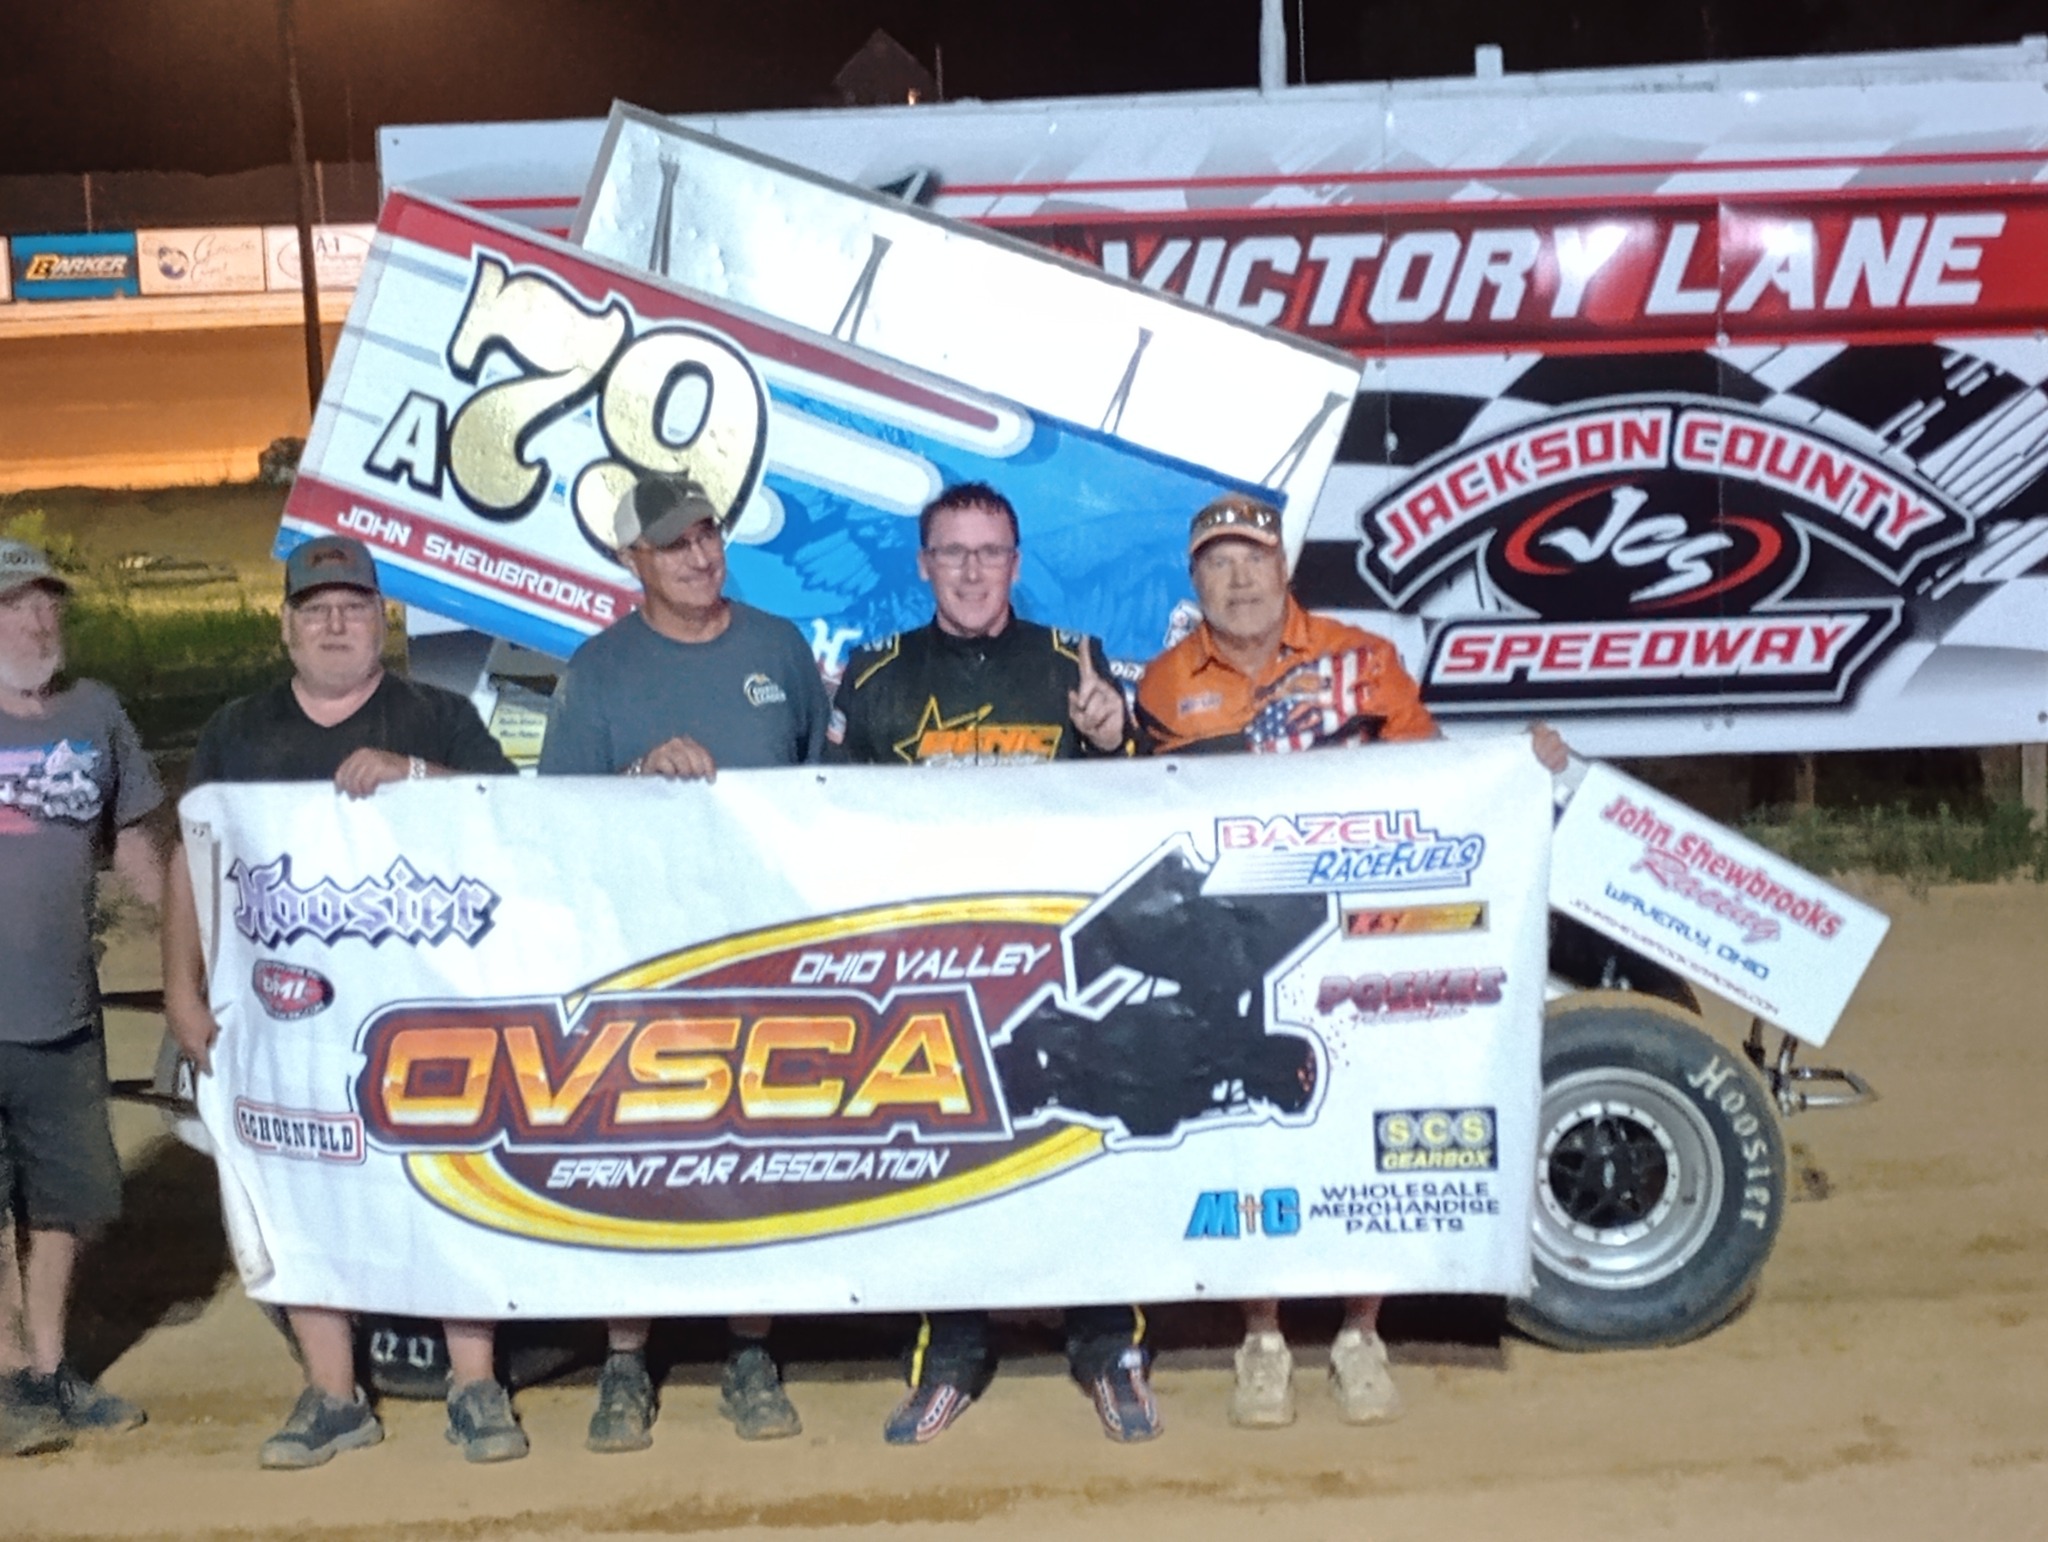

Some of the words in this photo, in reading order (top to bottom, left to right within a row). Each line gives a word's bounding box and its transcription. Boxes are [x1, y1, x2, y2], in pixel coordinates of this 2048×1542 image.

[26, 253, 128, 279] BARKER
[1102, 225, 1628, 327] VICTORY
[1645, 213, 2007, 316] LANE
[1378, 414, 1667, 562] JACKSON
[1680, 416, 1930, 546] COUNTY
[337, 505, 413, 547] JOHN
[422, 532, 616, 611] SHEWBROOKS
[1441, 624, 1850, 676] SPEEDWAY
[1219, 814, 1434, 850] BAZELL
[1603, 795, 1676, 851] John
[1674, 830, 1846, 940] Shewbrooks
[226, 852, 502, 950] Hoosier
[1630, 846, 1783, 944] Racing
[791, 949, 887, 984] OHIO
[896, 942, 1052, 982] VALLEY
[1716, 943, 1771, 981] OHIO
[382, 1012, 973, 1127] OVSCA
[238, 1109, 354, 1152] SCHOENFELD
[1381, 1112, 1493, 1149] SCS
[546, 1155, 668, 1189] SPRINT
[664, 1153, 741, 1187] CAR
[740, 1149, 951, 1185] ASSOCIATION
[1381, 1149, 1493, 1171] GEARBOX
[1308, 1199, 1501, 1218] MERCHANDISE
[1320, 1181, 1490, 1201] WHOLESALE
[1345, 1218, 1466, 1235] PALLETS
